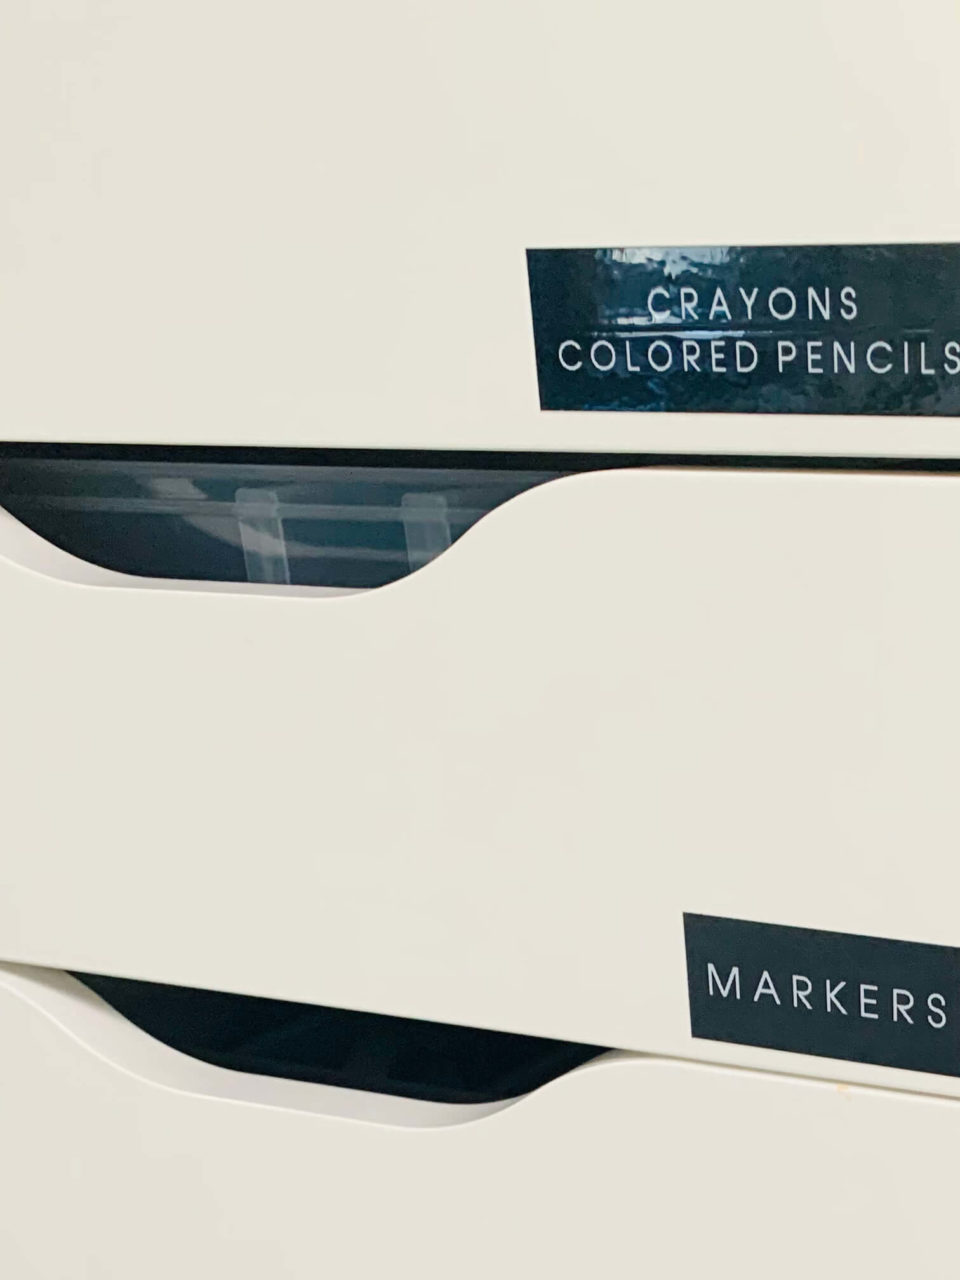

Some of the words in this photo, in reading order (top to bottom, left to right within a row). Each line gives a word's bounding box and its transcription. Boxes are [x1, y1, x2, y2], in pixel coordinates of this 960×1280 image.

[646, 285, 859, 321] CRAYONS
[557, 339, 759, 374] COLORED
[707, 962, 948, 1029] MARKERS
